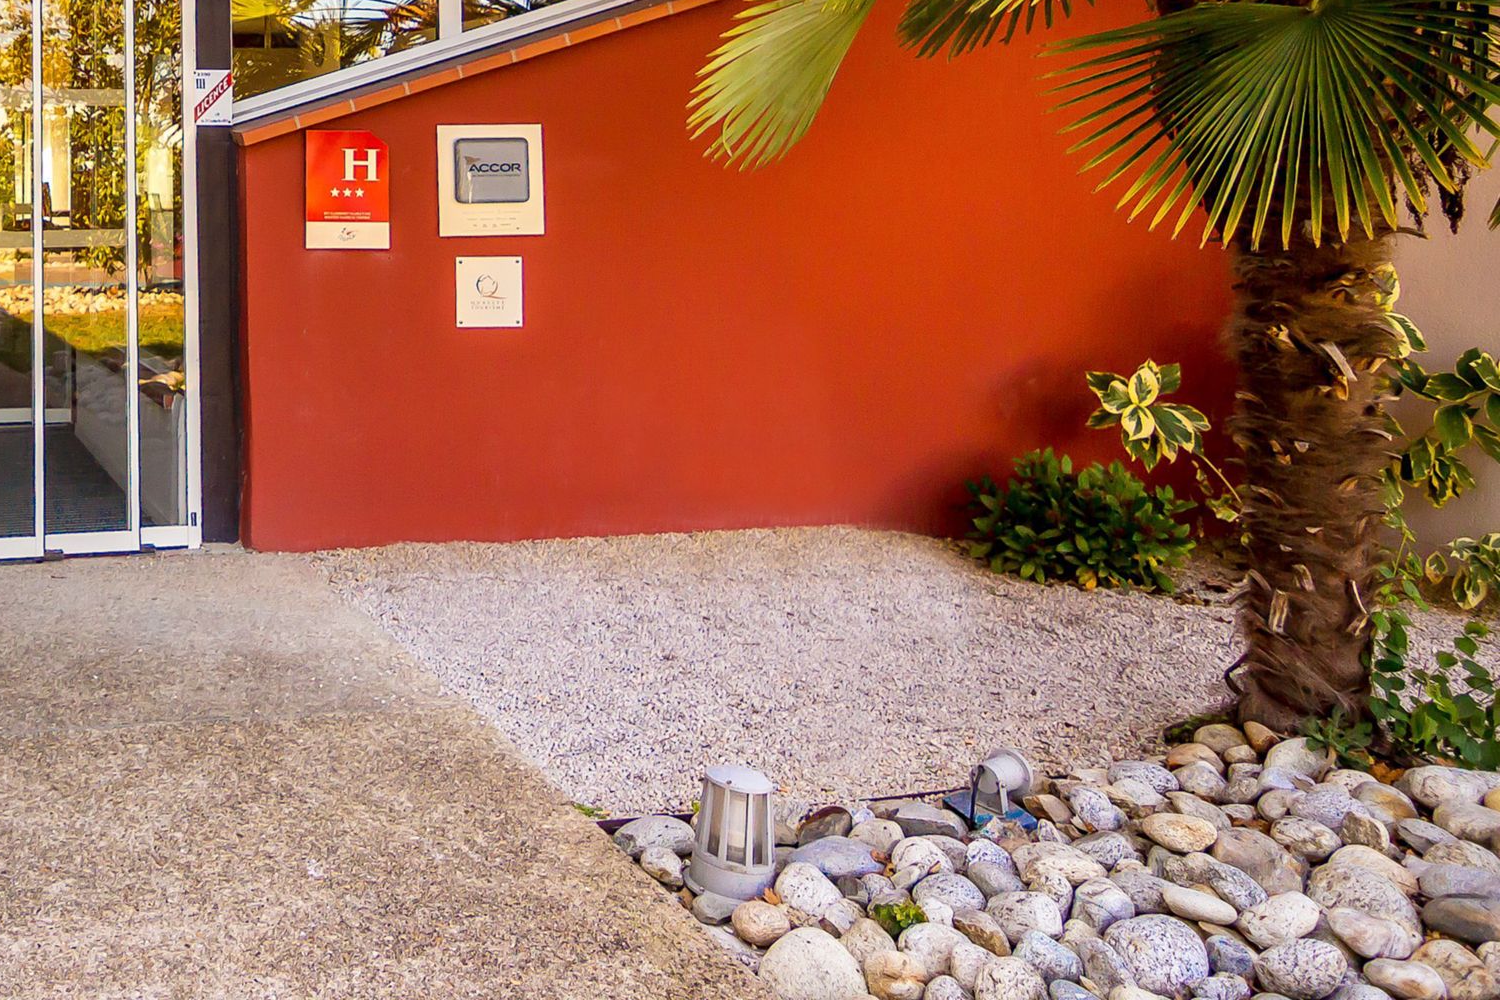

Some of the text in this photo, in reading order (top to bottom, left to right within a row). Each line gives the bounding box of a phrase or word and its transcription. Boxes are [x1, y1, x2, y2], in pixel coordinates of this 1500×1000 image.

[196, 76, 228, 116] LICENCE
[341, 147, 380, 182] H
[468, 163, 521, 173] ACCOR
